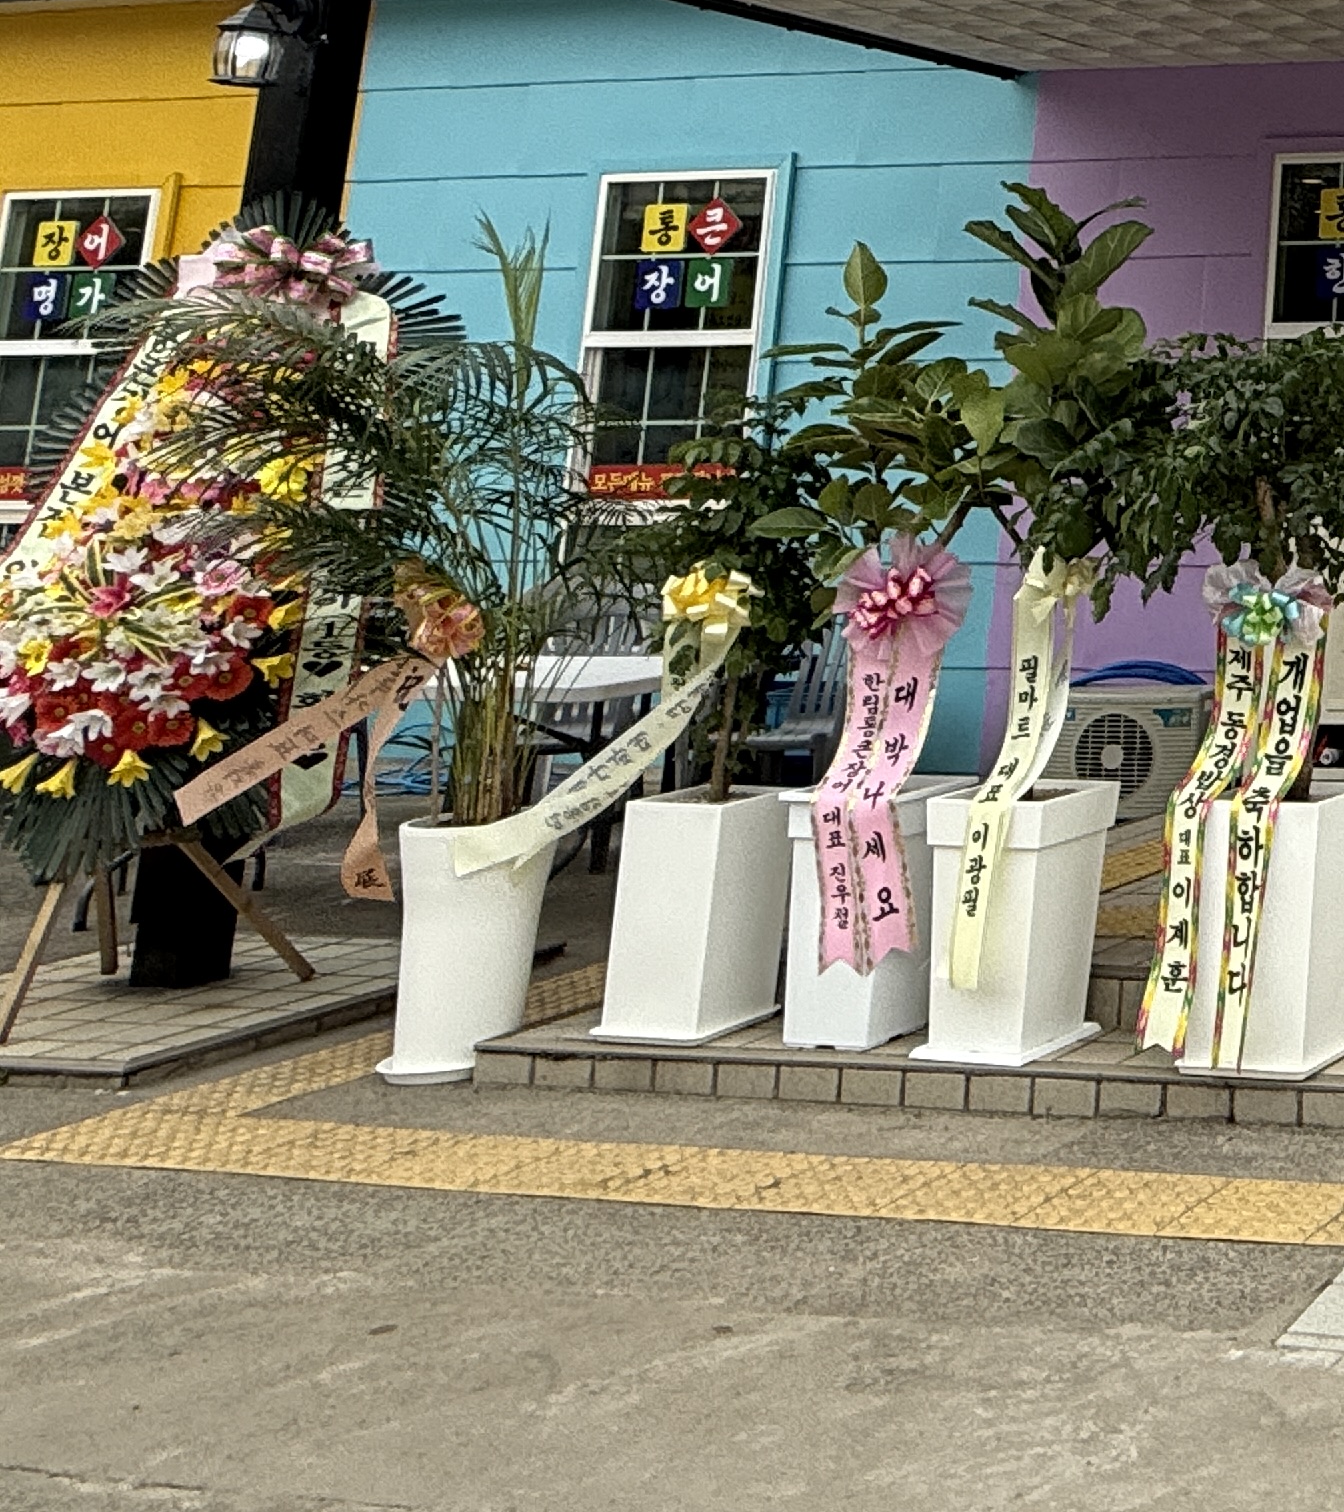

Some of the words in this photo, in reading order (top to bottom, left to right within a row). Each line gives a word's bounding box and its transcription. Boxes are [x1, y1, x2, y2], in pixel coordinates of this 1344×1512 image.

[1226, 648, 1256, 702] 제주
[1263, 650, 1309, 777] 개업을
[822, 806, 846, 850] 대표
[861, 676, 919, 922] 대박나세요
[1161, 876, 1192, 994] 이제훈
[1227, 784, 1270, 1009] 축하합니다
